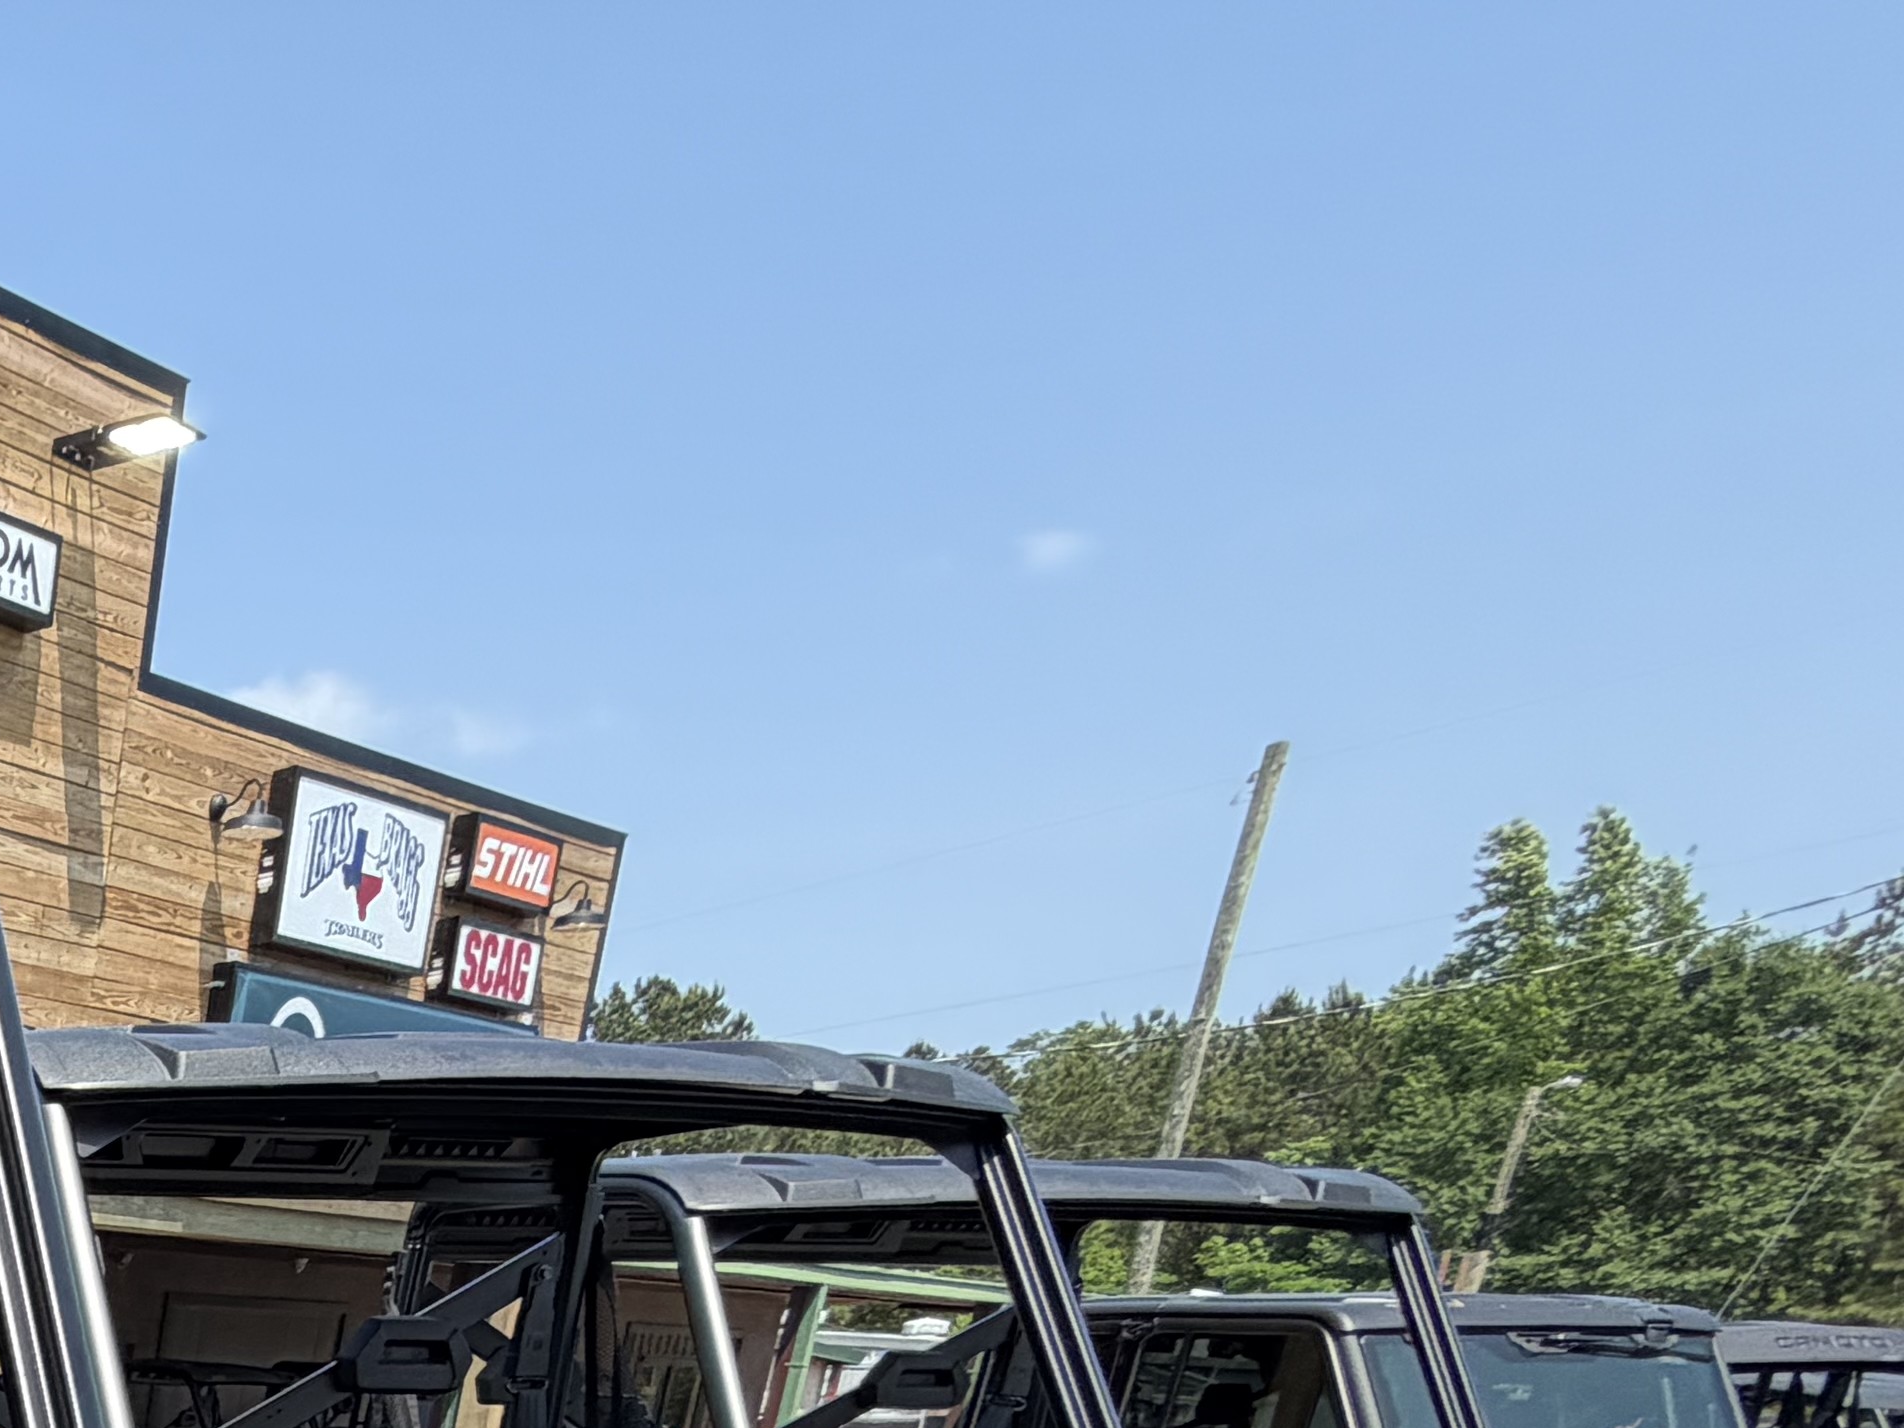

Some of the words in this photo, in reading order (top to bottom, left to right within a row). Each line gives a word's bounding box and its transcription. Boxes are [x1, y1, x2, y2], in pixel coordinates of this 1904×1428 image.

[300, 802, 358, 898] TEXAS
[472, 836, 551, 897] STIHL
[324, 918, 384, 950] TRAILERS
[459, 928, 533, 1003] SCAG
